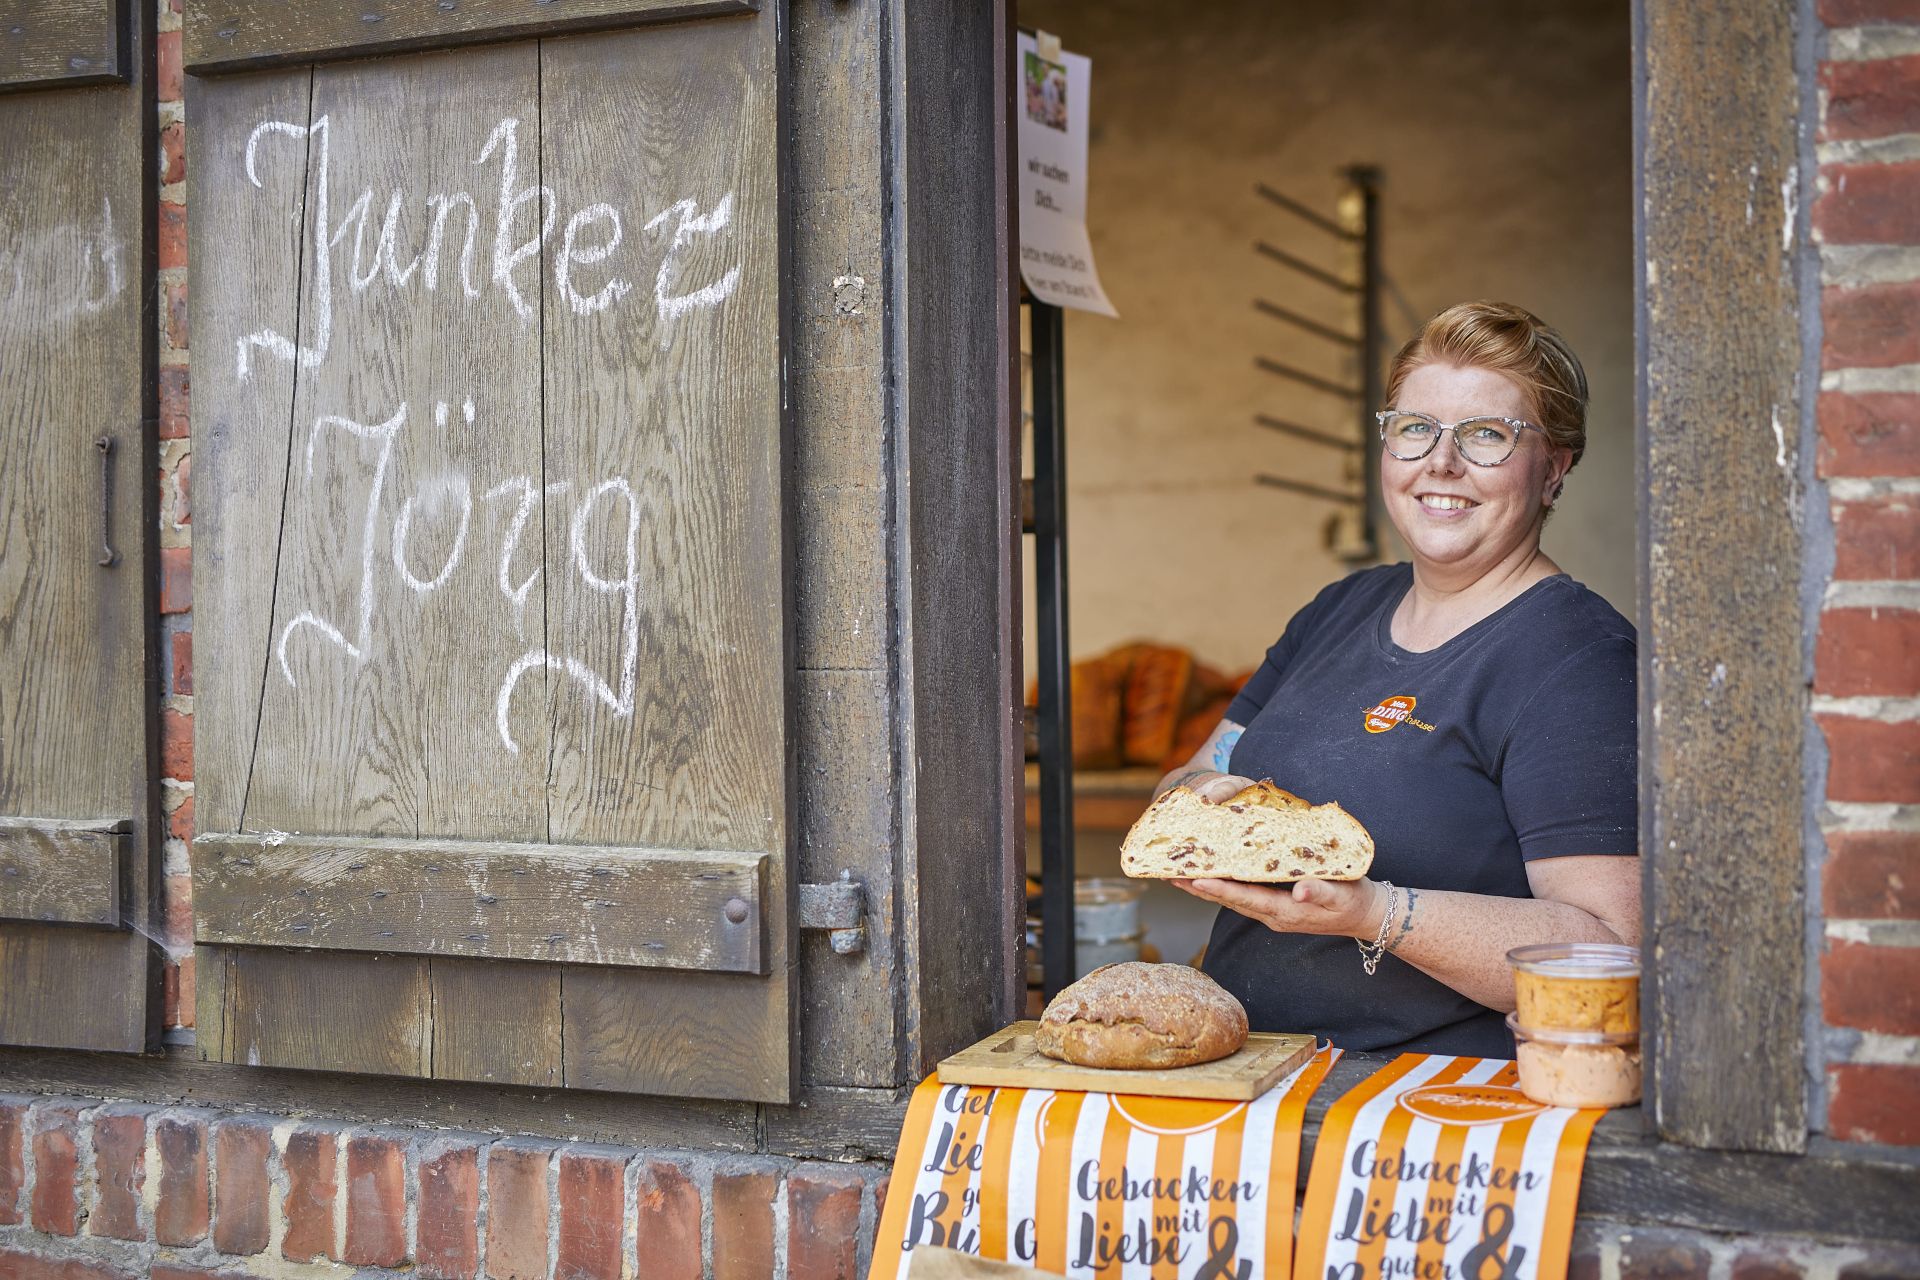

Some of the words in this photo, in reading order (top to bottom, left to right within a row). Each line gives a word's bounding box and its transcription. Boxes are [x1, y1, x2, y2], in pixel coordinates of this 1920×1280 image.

[238, 115, 741, 382] Junker
[279, 400, 640, 754] Jörg
[1077, 1160, 1260, 1202] Gebacken
[1351, 1139, 1543, 1191] Gebacken
[1156, 1208, 1208, 1233] mit
[1334, 1187, 1464, 1245] Liebe
[1428, 1194, 1487, 1216] mit
[1071, 1212, 1192, 1271] Liebe
[1378, 1253, 1457, 1280] guter
